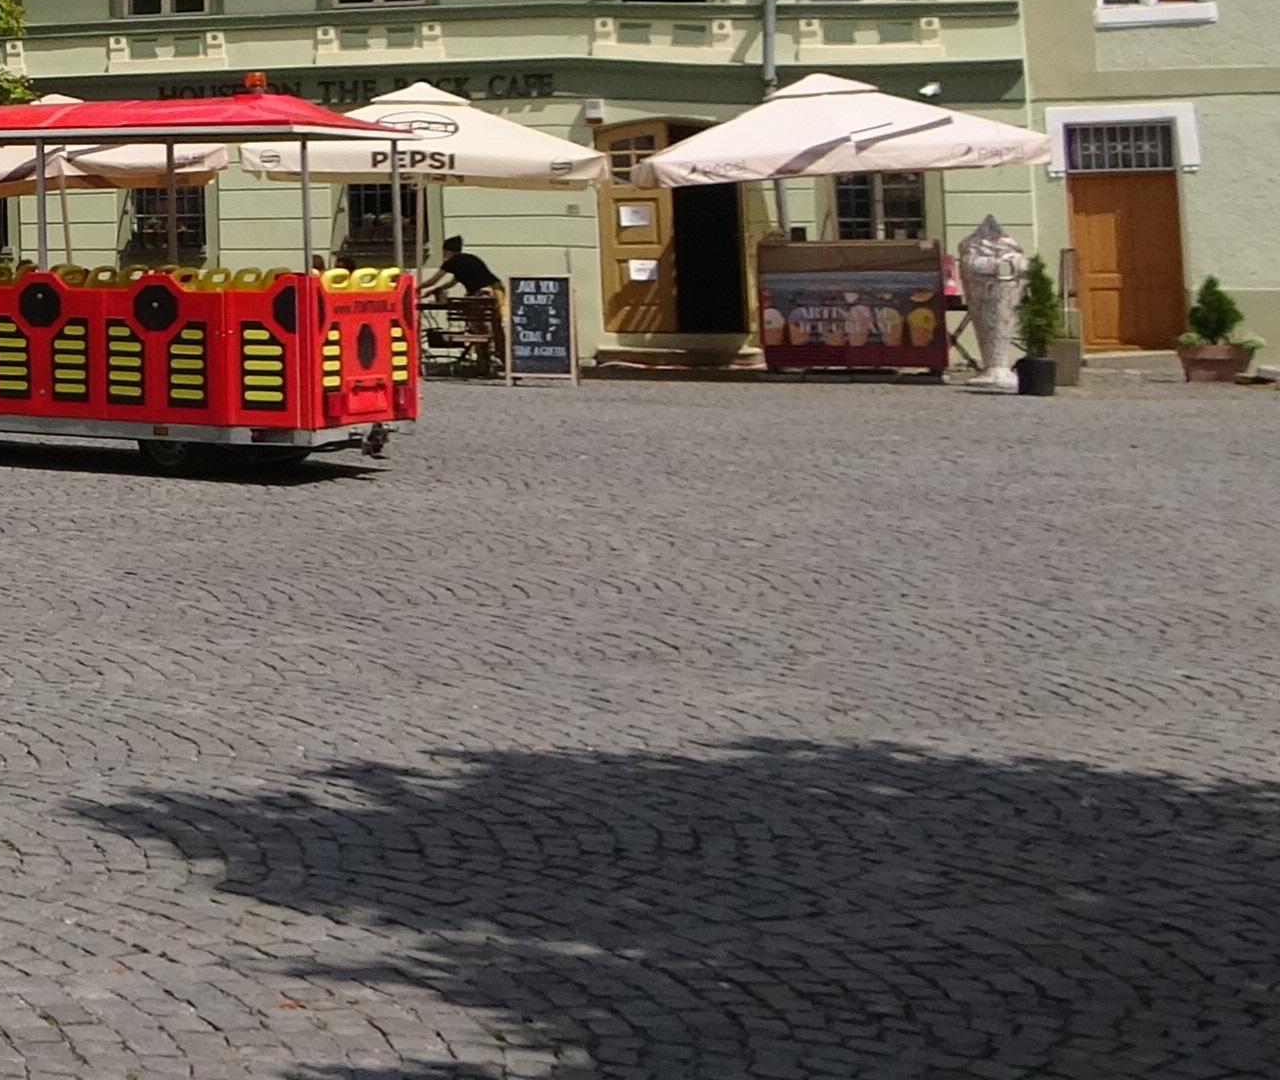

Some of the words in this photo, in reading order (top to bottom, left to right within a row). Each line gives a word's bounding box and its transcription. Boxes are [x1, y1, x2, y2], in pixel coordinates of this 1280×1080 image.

[318, 79, 377, 103] THE
[393, 76, 471, 99] RCK
[487, 72, 554, 99] CAFE
[370, 150, 456, 170] PEPSI
